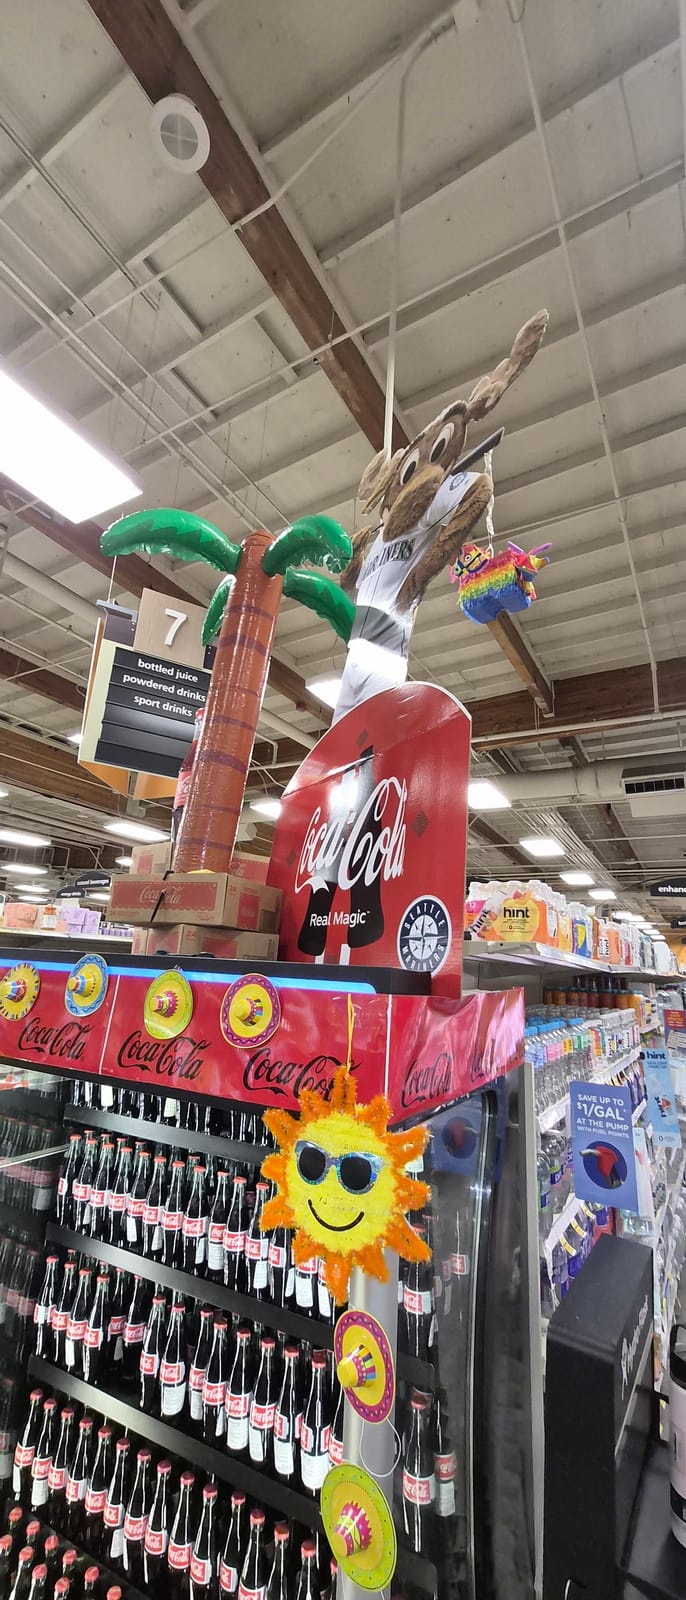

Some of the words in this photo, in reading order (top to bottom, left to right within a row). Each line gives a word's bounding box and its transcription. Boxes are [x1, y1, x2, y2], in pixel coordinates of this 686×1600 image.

[164, 608, 188, 646] 7
[137, 658, 175, 676] bottled
[175, 669, 199, 683] juice
[122, 674, 175, 694] powdered
[176, 687, 206, 702] drinks
[133, 695, 161, 709] sport
[162, 702, 193, 717] drinks
[309, 911, 332, 928] Real
[403, 902, 446, 930] SEATTLE
[503, 906, 530, 919] hint
[117, 1030, 212, 1080] Coca-Cola
[646, 1051, 666, 1060] hint
[242, 1047, 362, 1101] Coca-Co
[577, 1093, 598, 1103] SAVE
[599, 1096, 611, 1104] UP
[612, 1098, 624, 1106] TO
[576, 1117, 586, 1125] AT
[588, 1118, 604, 1128] THE
[605, 1121, 629, 1132] PUMP
